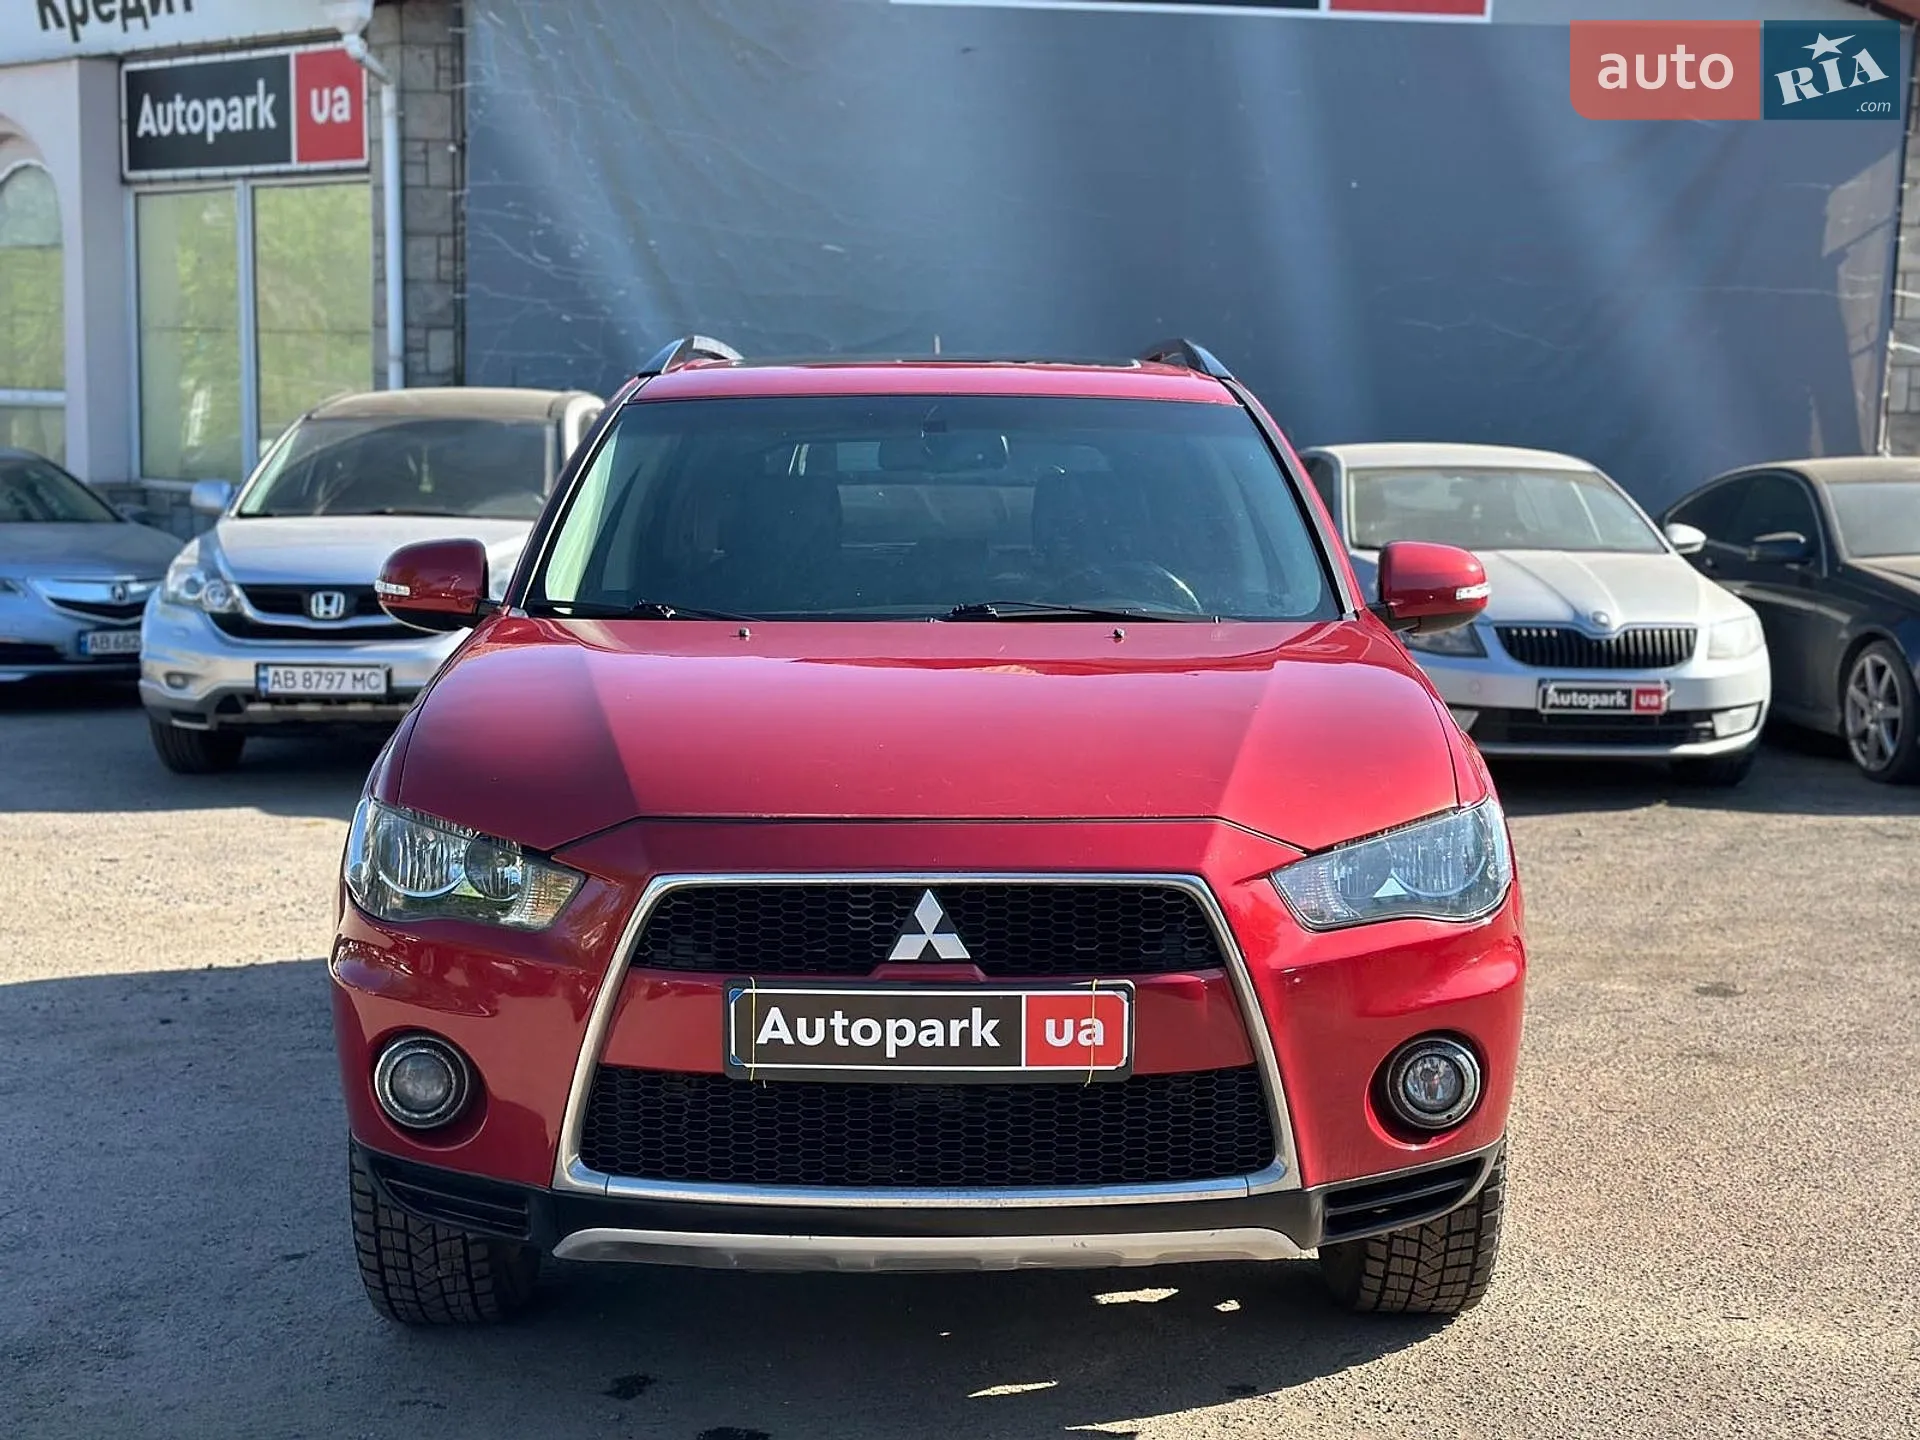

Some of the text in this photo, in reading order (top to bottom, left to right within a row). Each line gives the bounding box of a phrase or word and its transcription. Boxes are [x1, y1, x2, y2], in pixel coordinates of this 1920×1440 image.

[137, 79, 350, 144] Autopark ua
[271, 670, 381, 690] AB 8797 MC
[1548, 690, 1660, 709] Autopark ua
[756, 1006, 1104, 1058] Autopark ua
